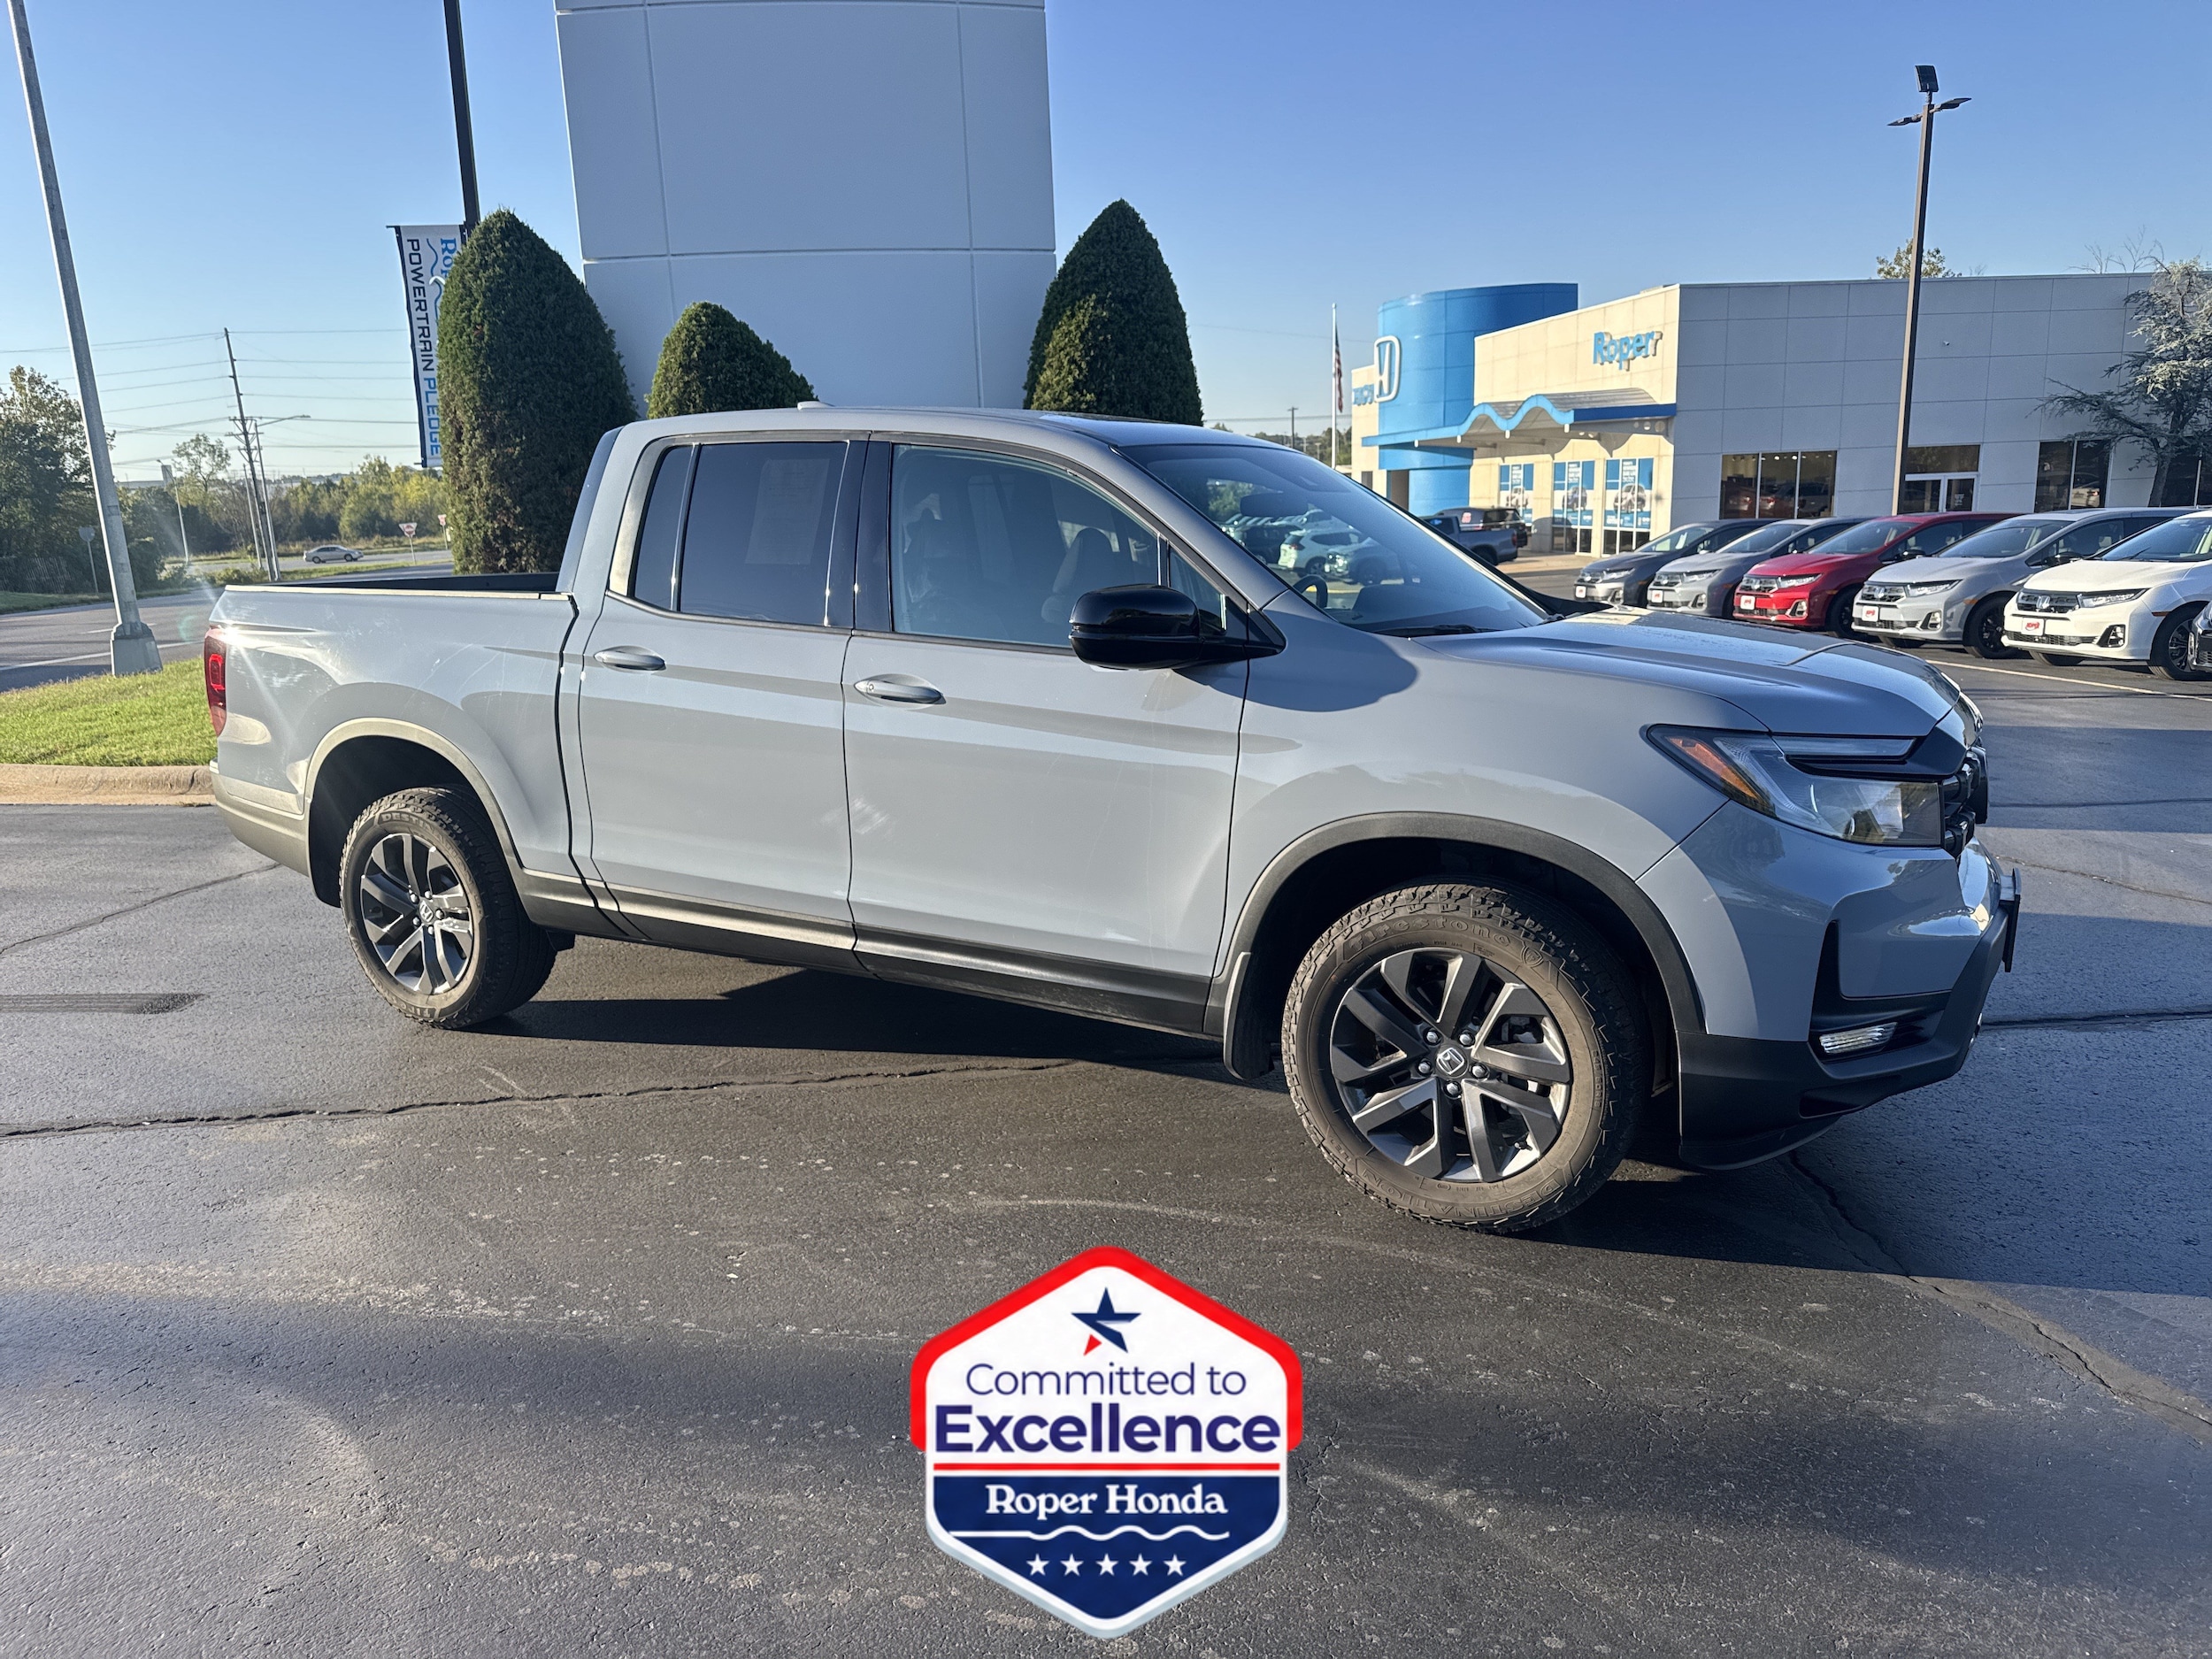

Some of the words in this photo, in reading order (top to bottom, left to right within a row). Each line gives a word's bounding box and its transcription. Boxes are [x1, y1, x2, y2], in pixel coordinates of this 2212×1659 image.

[407, 238, 434, 372] POWERTRAIN
[424, 377, 442, 456] PLEDGE
[1593, 330, 1659, 371] Roper
[1349, 915, 1510, 952] Firestone
[1361, 1167, 1563, 1218] DESTINATION
